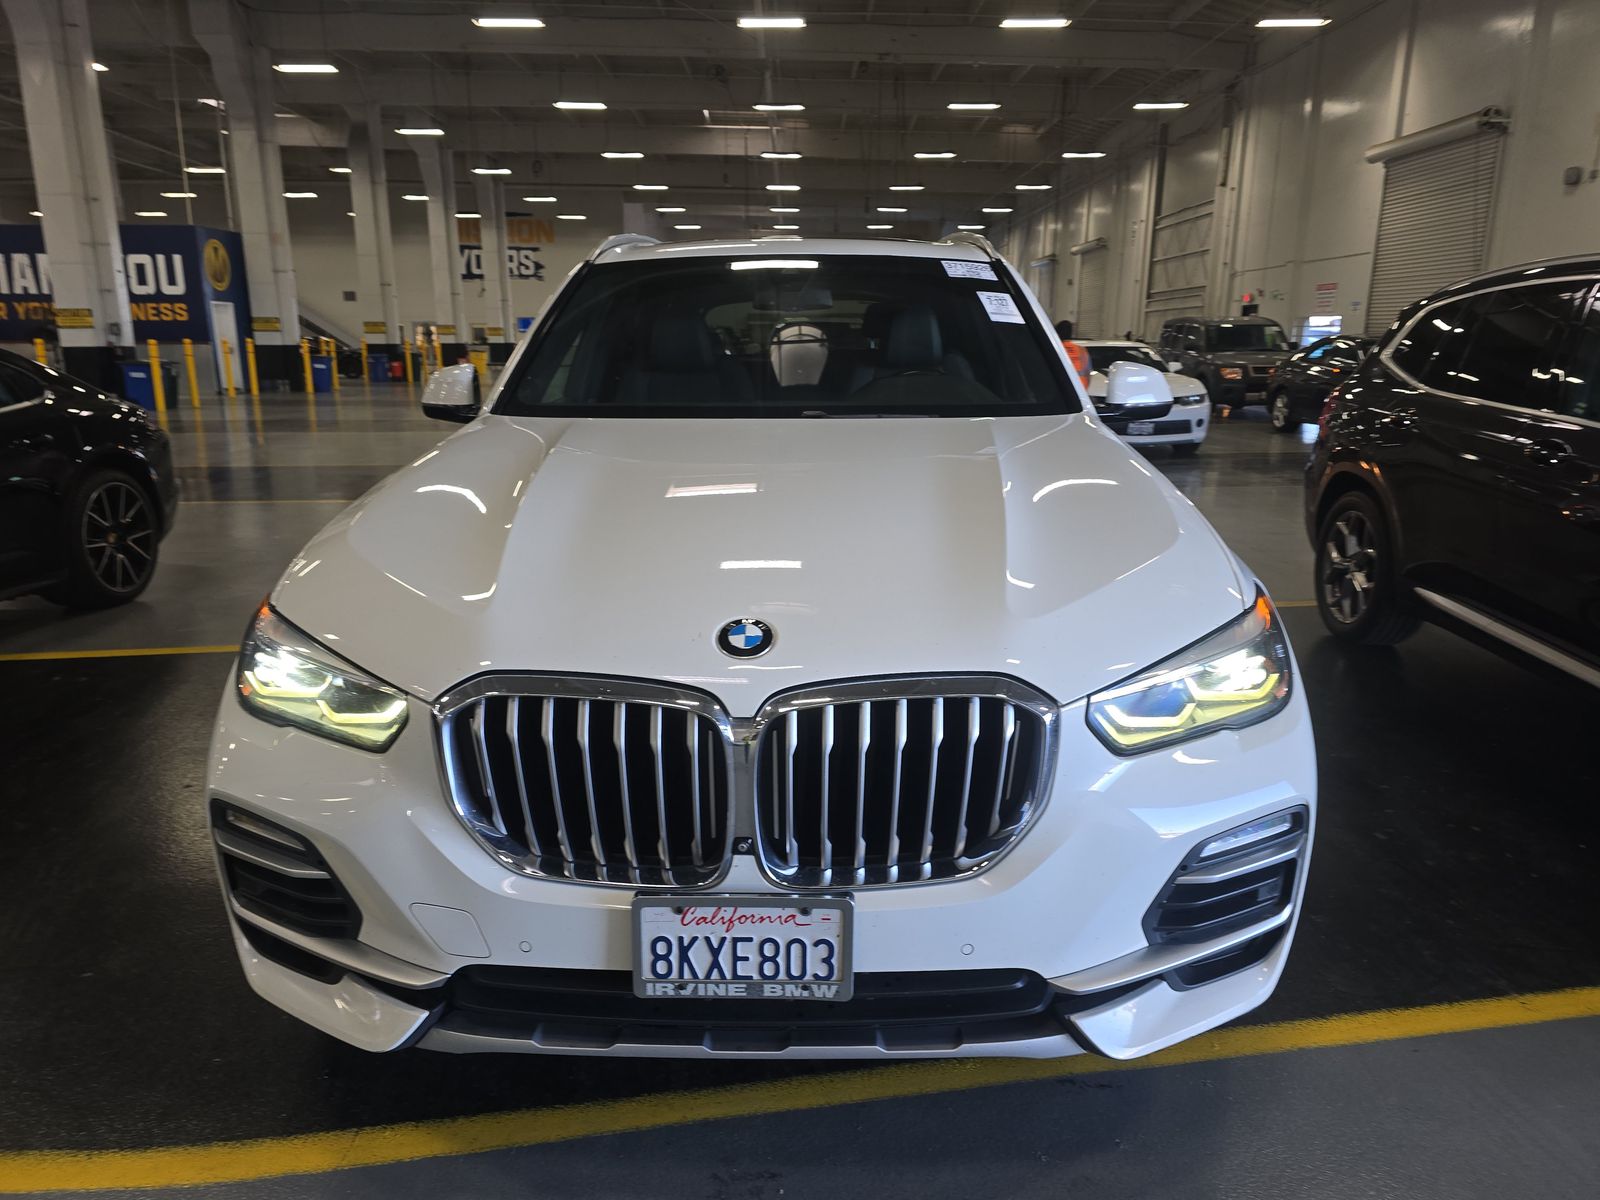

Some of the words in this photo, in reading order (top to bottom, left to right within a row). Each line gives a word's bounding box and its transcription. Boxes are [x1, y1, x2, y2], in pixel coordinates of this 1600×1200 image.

[126, 253, 187, 295] OU
[680, 906, 812, 933] California
[649, 935, 835, 980] 8KXE803
[645, 982, 748, 996] IRVINE
[763, 984, 839, 998] BMW
